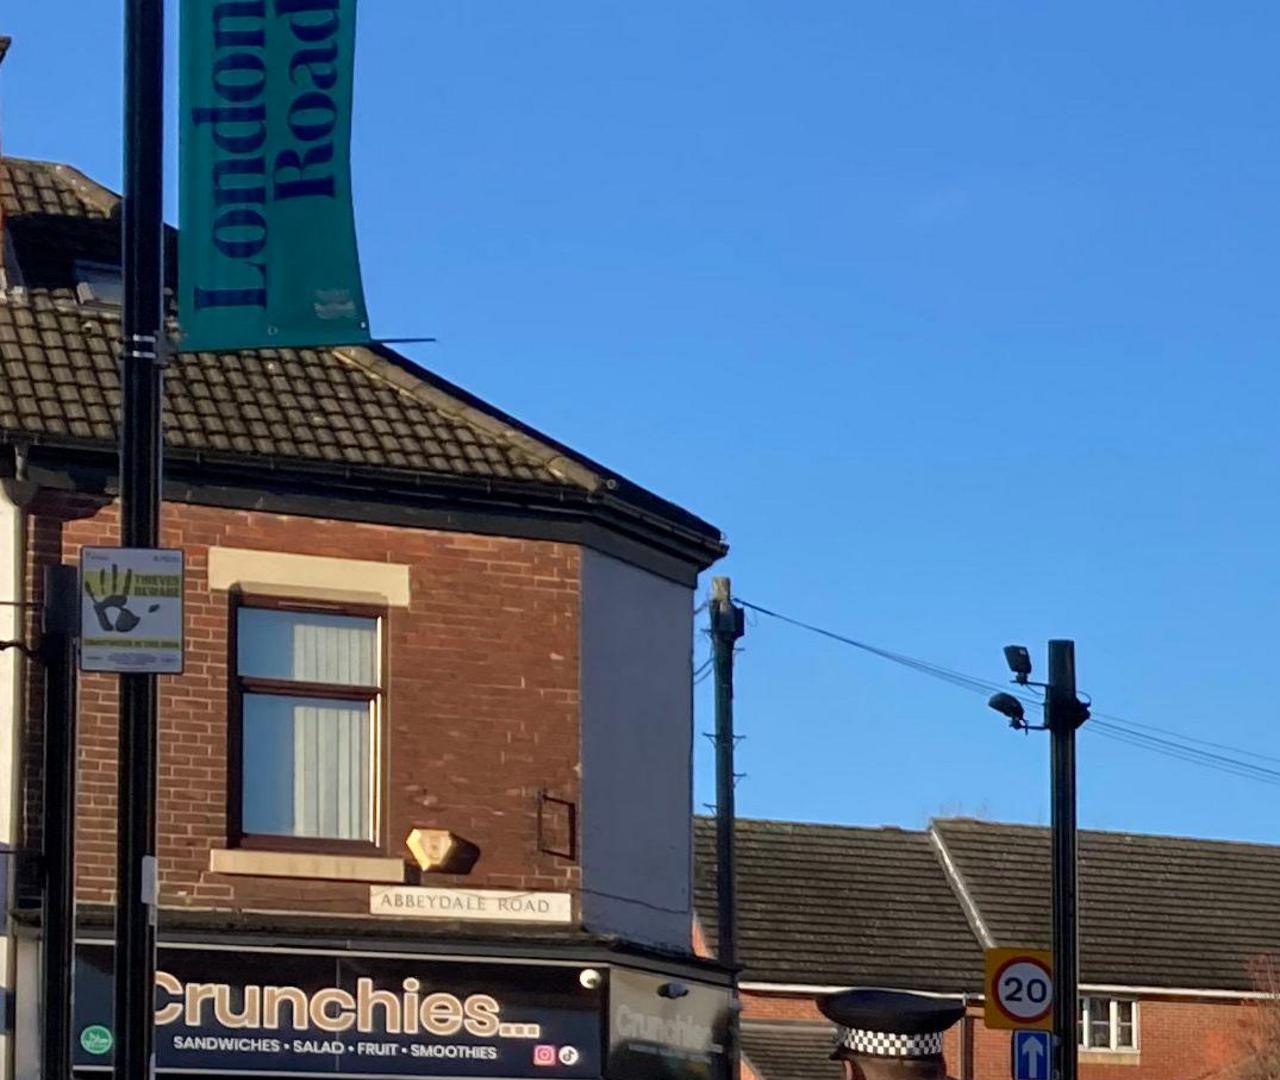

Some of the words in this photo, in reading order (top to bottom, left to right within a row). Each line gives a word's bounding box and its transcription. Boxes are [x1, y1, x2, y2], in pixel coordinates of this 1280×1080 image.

[273, 0, 341, 200] Road
[191, 1, 268, 311] London
[380, 893, 488, 912] ABBEYDALE
[498, 898, 550, 914] ROAD
[1004, 976, 1048, 1003] 20
[173, 1036, 281, 1053] SANDWICHES
[293, 1038, 345, 1055] SALAD
[357, 1041, 398, 1056] FRUIT
[410, 1043, 498, 1060] SMOOTHIES
